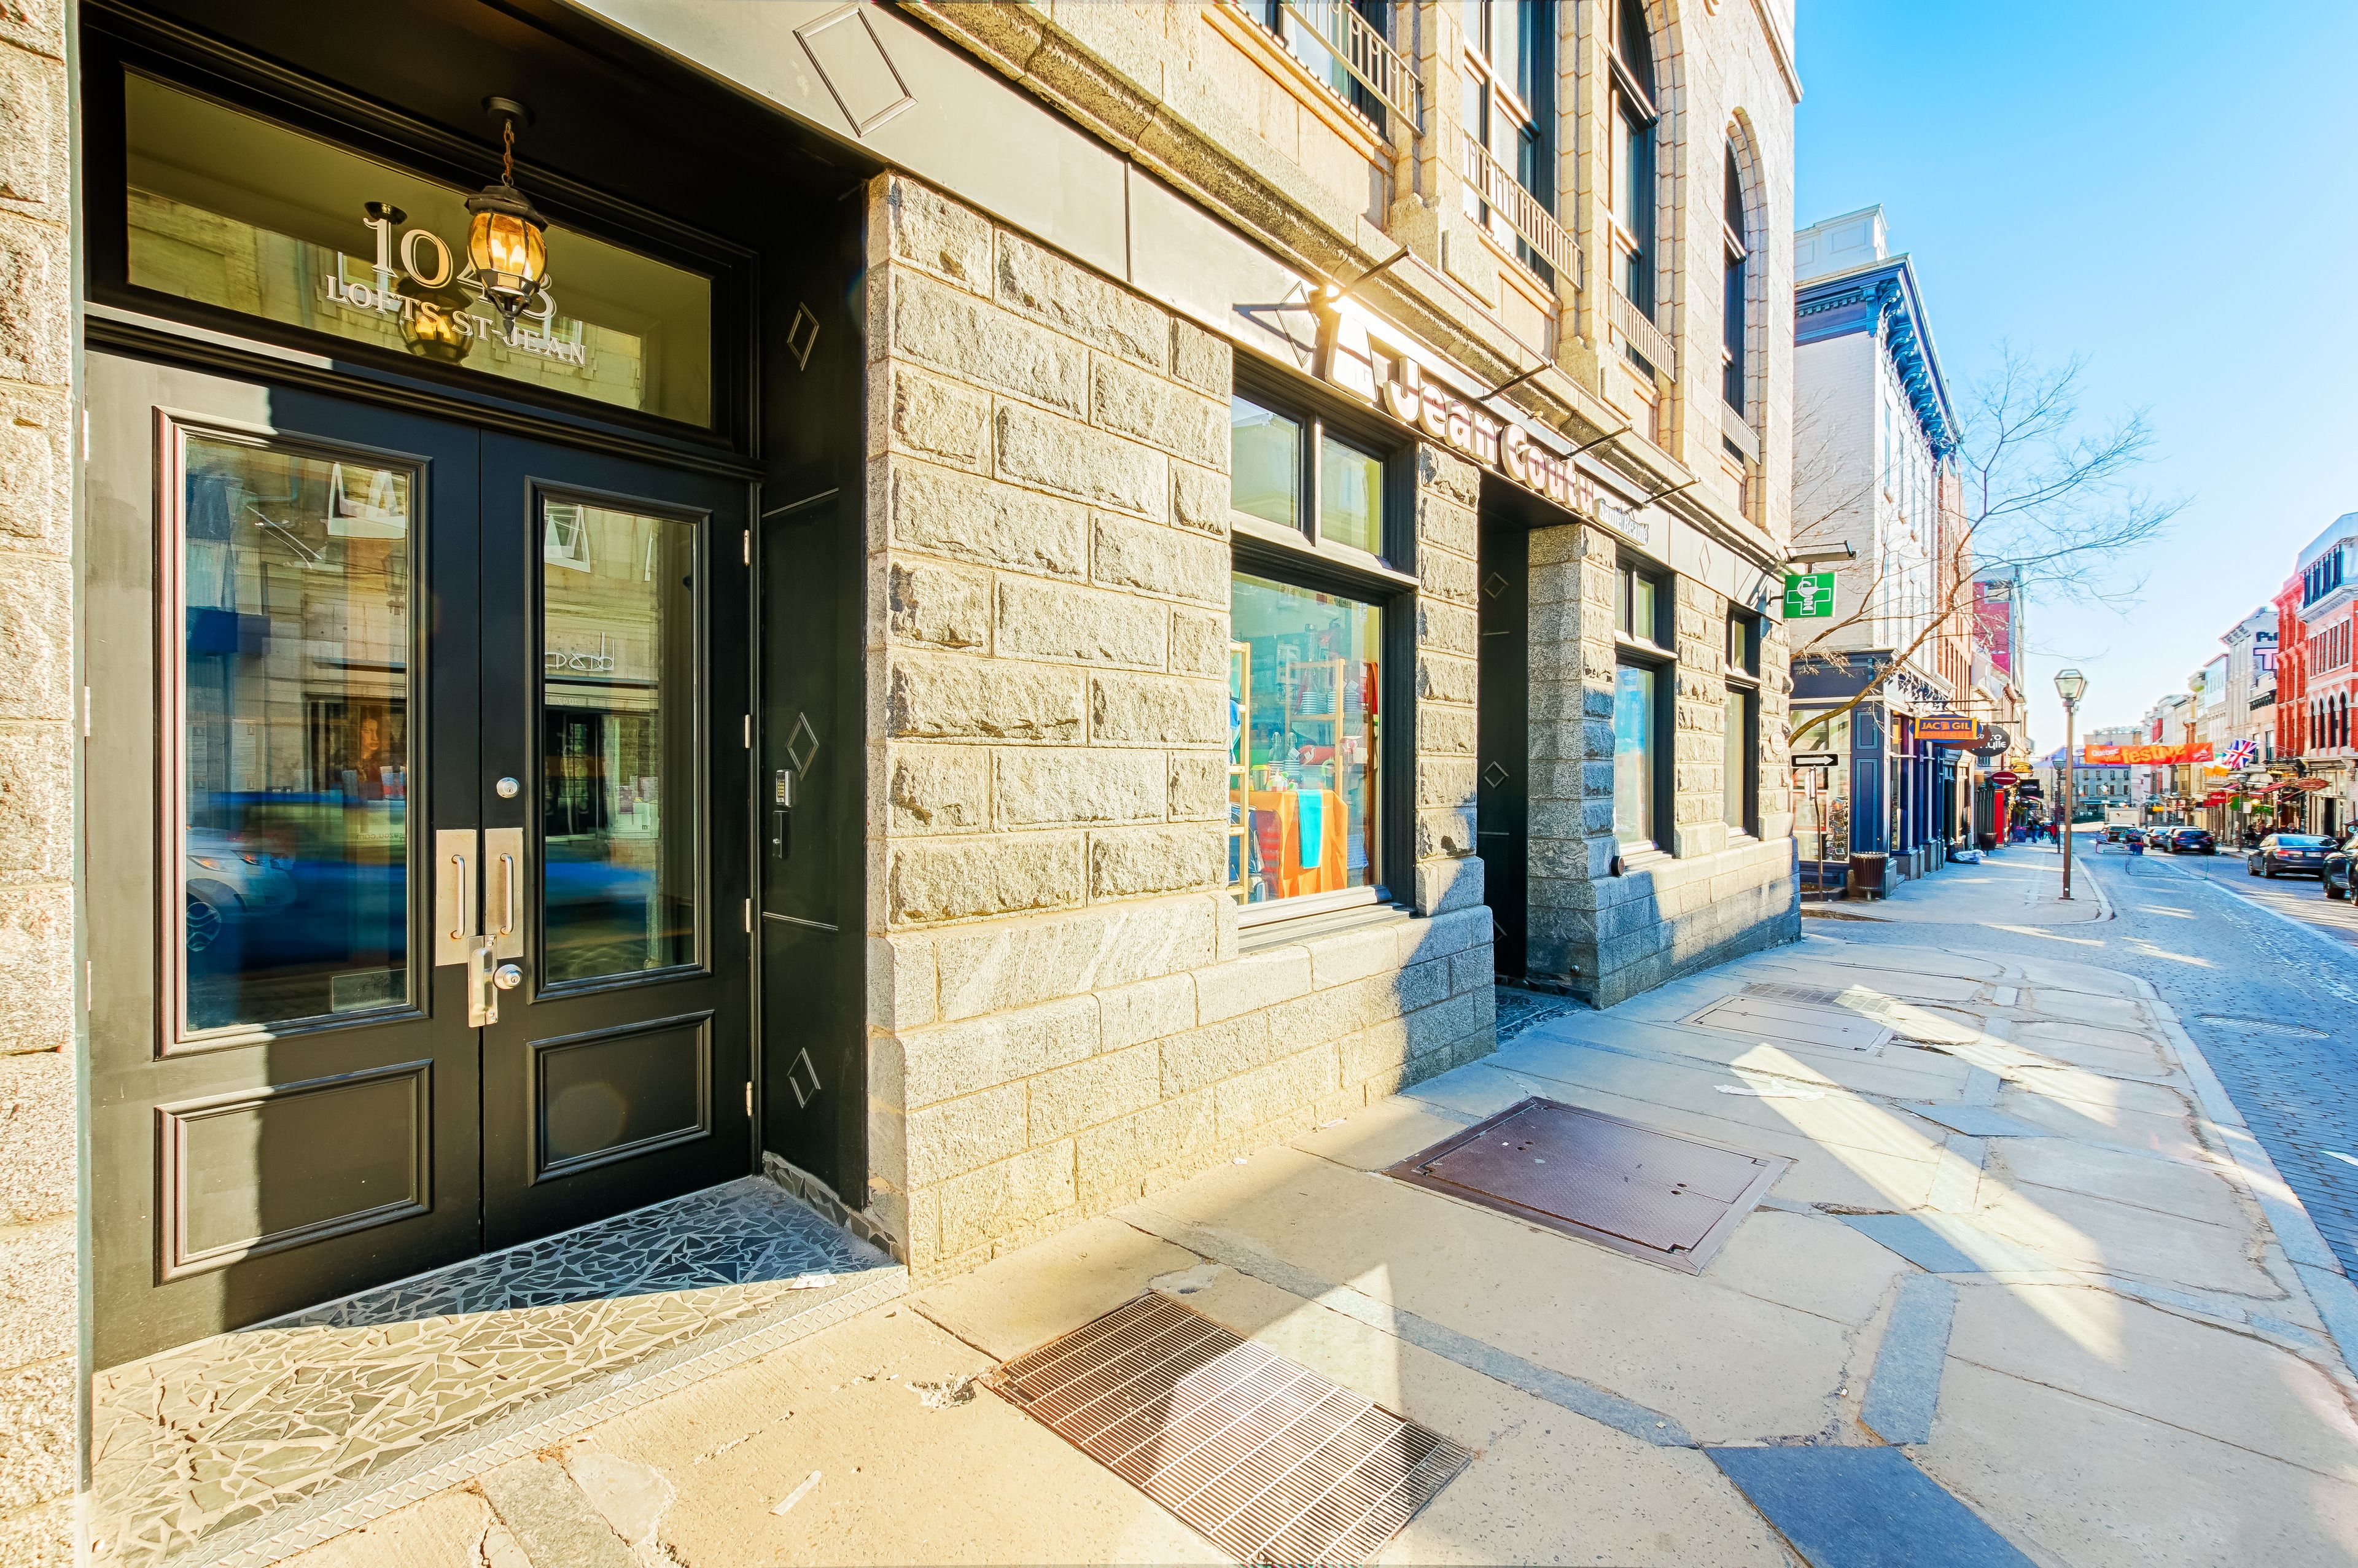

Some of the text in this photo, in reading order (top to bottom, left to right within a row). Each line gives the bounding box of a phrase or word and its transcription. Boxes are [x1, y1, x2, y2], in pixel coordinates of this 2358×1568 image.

[325, 274, 588, 367] LOFTS ST-JEAN
[1383, 356, 1595, 518] Jean Coutu
[1951, 721, 1971, 730] GIL
[2121, 745, 2186, 764] festive
